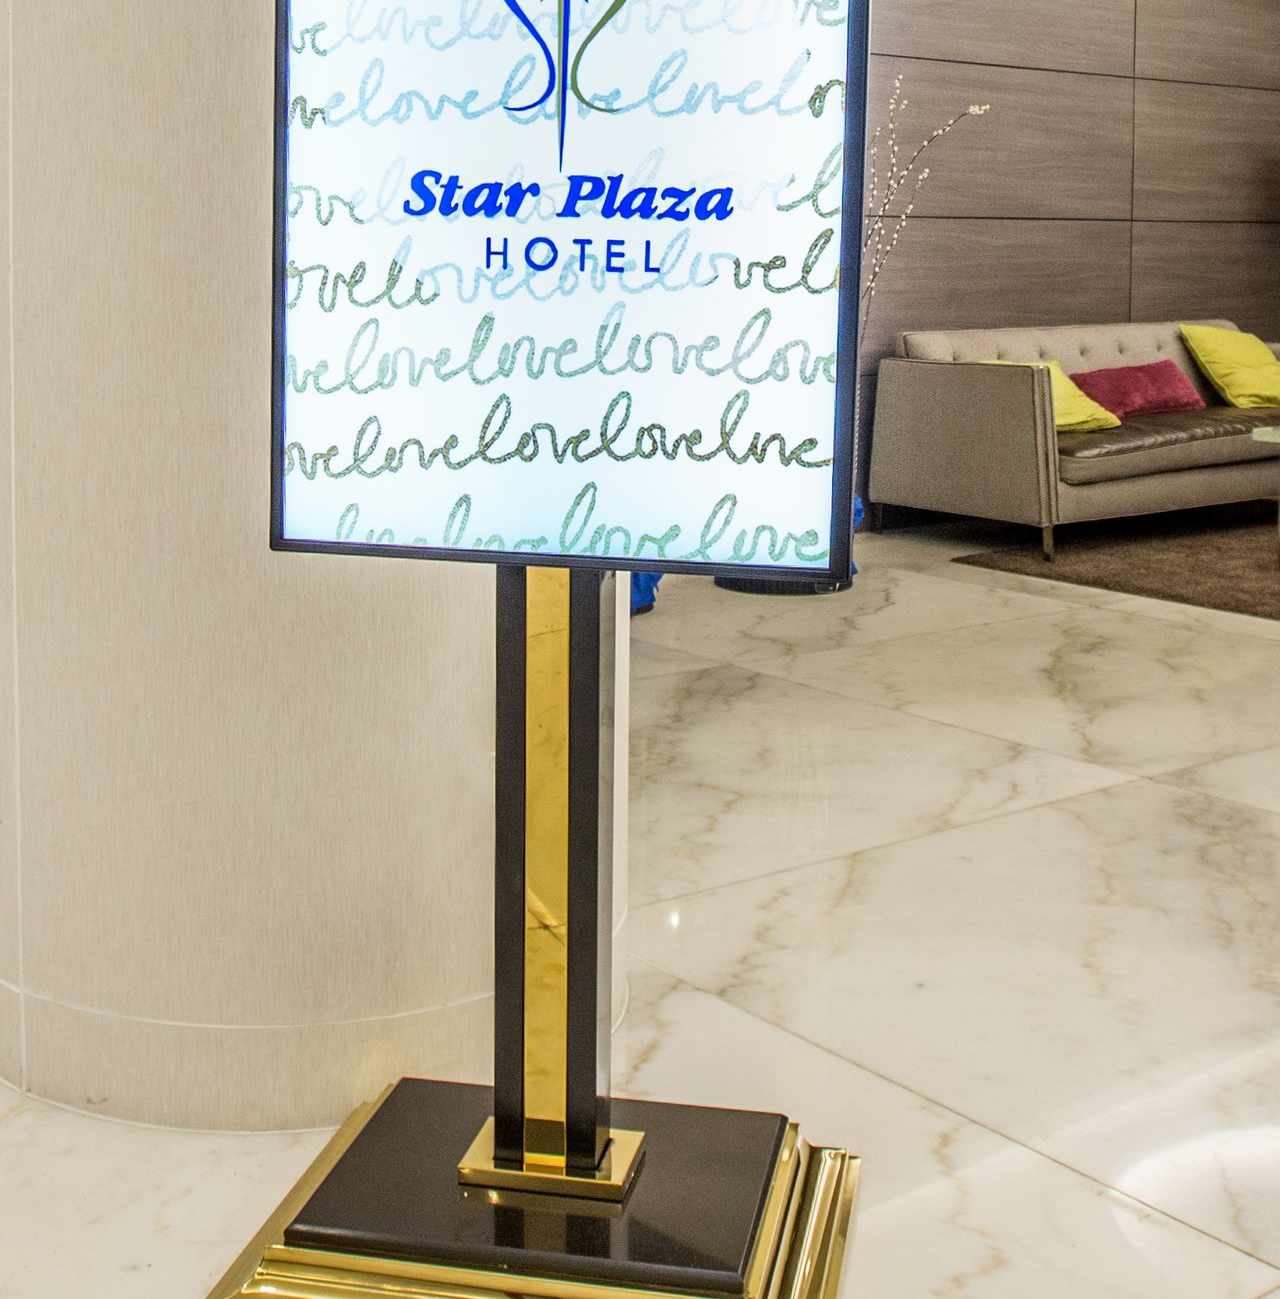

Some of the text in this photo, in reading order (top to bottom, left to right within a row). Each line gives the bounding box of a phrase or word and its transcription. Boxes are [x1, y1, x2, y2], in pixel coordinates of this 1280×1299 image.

[403, 169, 735, 222] Star Plaza
[486, 237, 661, 273] HOTEL
